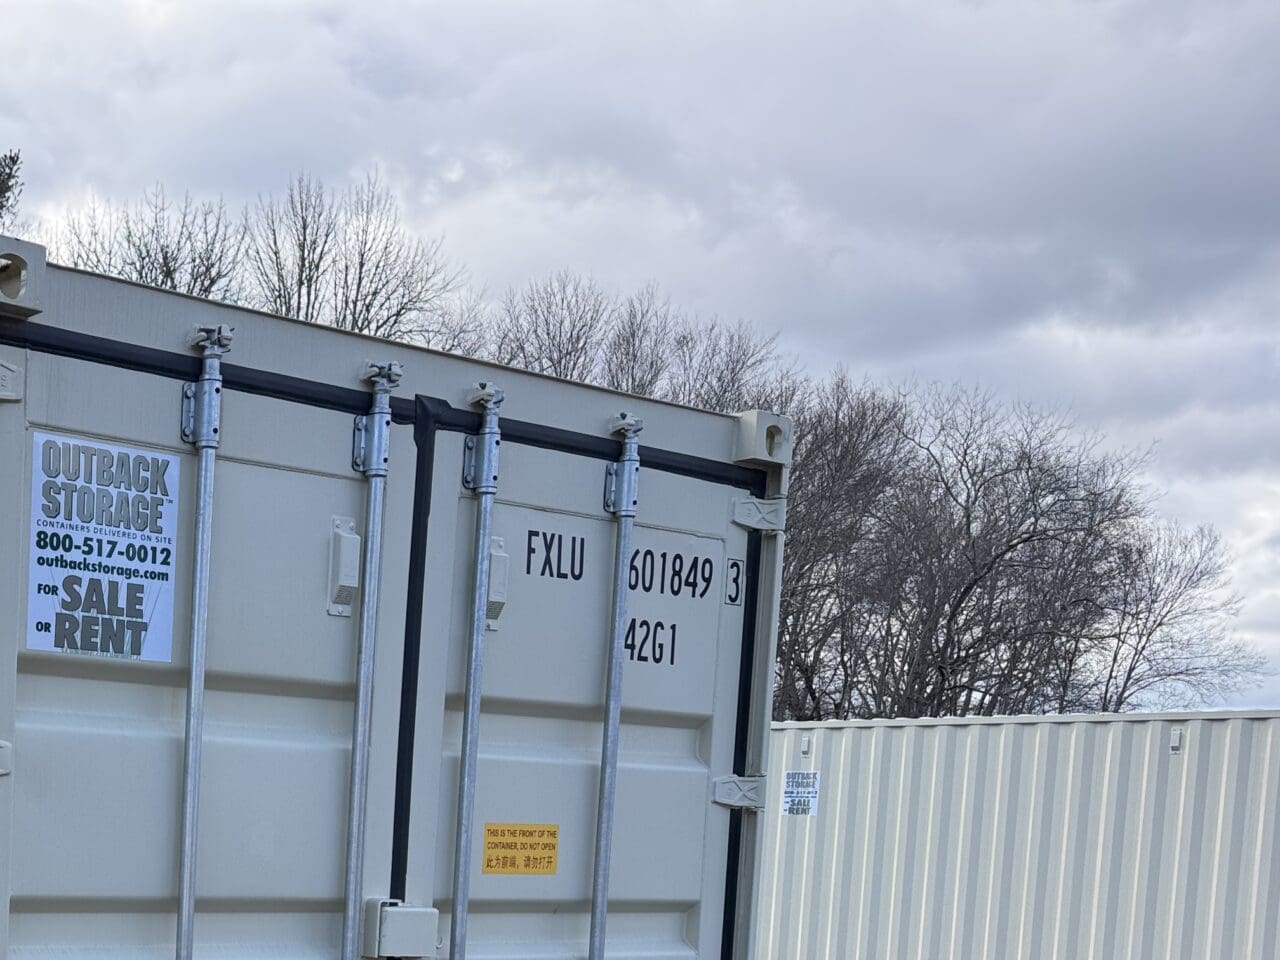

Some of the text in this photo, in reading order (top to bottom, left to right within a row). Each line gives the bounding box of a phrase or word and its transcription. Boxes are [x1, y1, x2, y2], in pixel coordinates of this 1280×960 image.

[41, 439, 170, 496] OUTBACK
[41, 479, 164, 534] STORAGE
[36, 519, 173, 544] CONTAINERS DELIVERED ON SITE
[36, 530, 172, 566] 800-517-0012
[36, 554, 169, 581] outbackstorage.com
[526, 529, 741, 603] FXLU 601849 3
[37, 574, 145, 619] FOR SALE
[35, 612, 148, 656] OR RENT
[624, 617, 677, 666] 42G1
[486, 829, 558, 838] THIS IS THE FRONT OF THE
[520, 842, 528, 850] DO
[529, 842, 540, 850] NOT
[541, 842, 556, 851] OPEN
